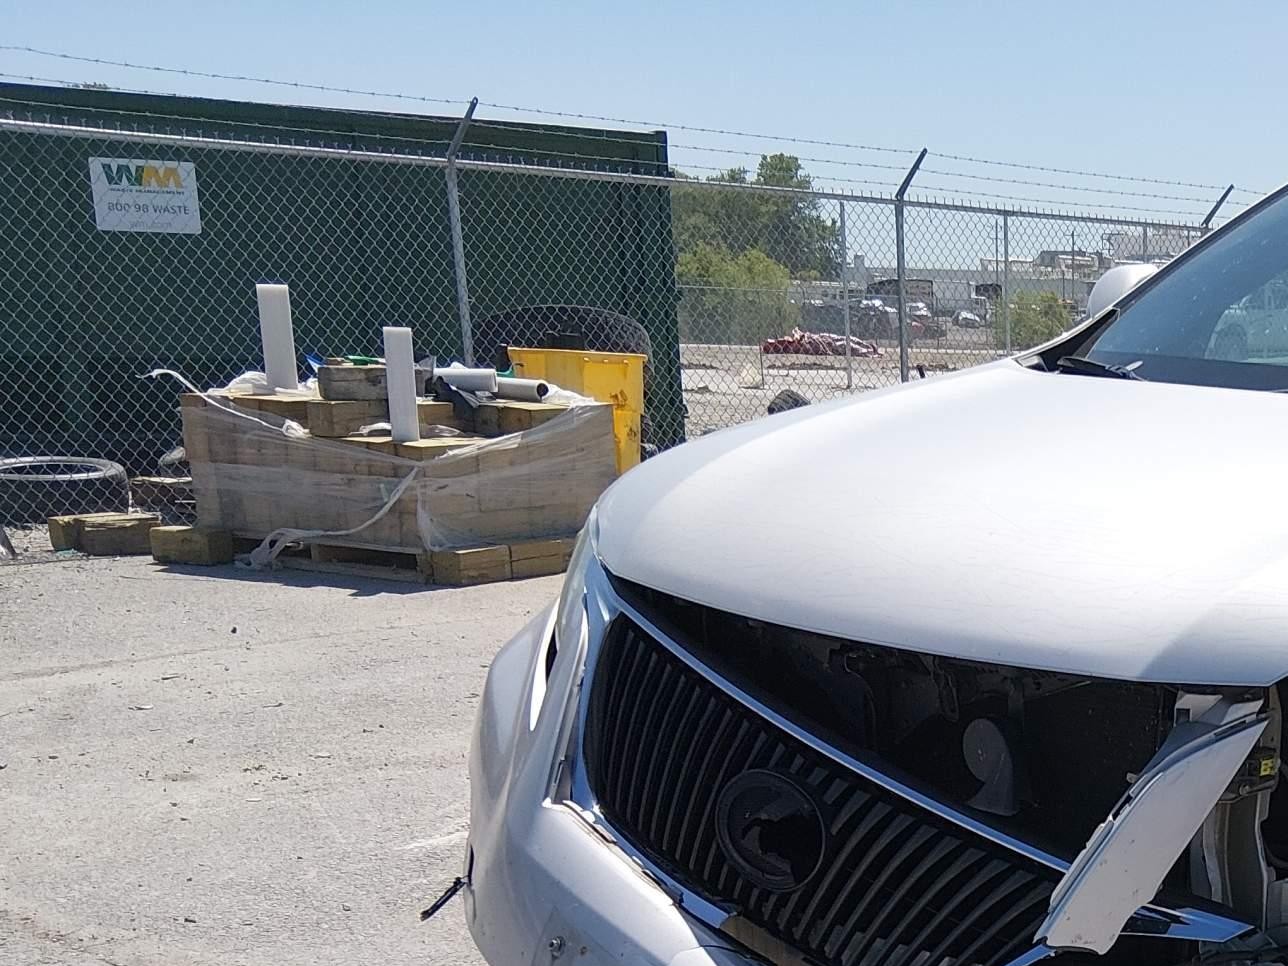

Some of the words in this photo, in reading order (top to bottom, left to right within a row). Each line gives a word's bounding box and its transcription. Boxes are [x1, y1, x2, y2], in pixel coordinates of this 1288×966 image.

[102, 163, 183, 188] WM
[107, 202, 130, 213] 800
[134, 202, 149, 214] 98
[152, 204, 190, 215] WASTE
